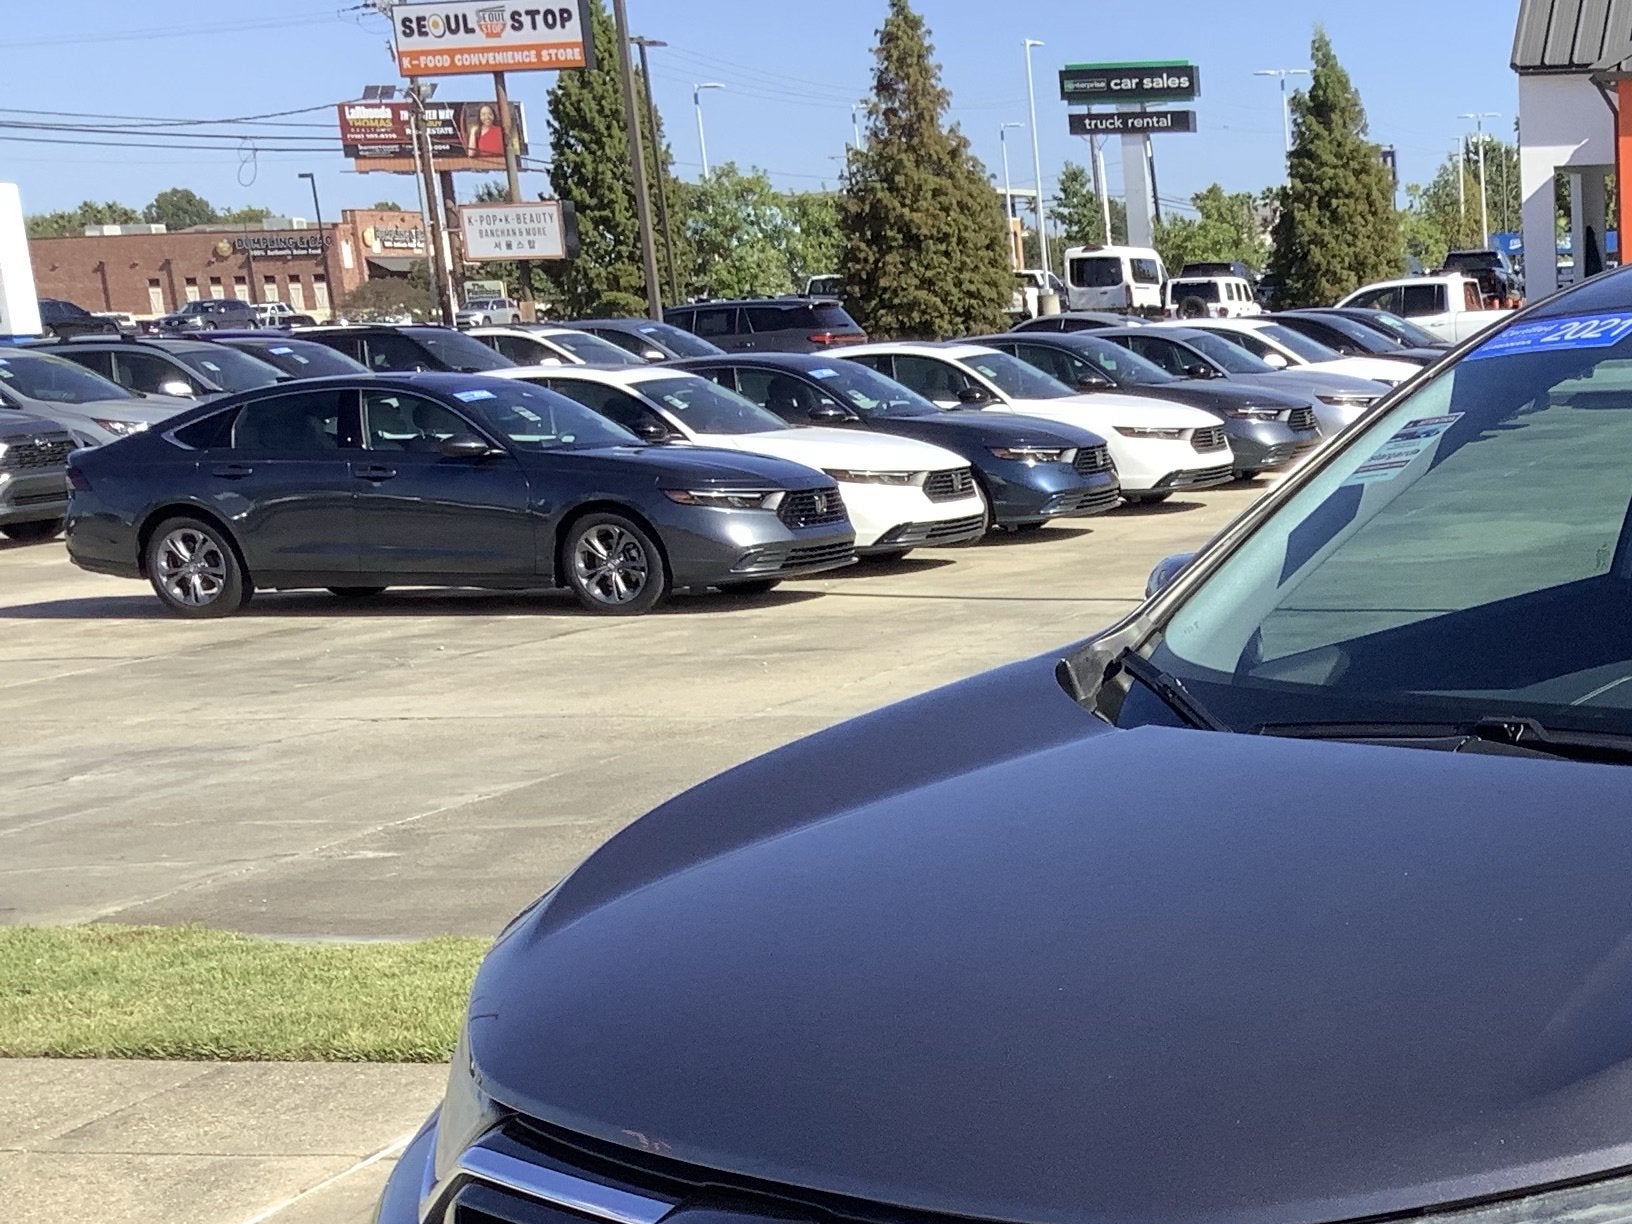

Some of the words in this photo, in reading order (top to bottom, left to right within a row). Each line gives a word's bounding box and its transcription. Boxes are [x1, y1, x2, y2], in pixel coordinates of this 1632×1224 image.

[401, 13, 476, 38] SEOUL
[510, 8, 573, 31] STOP
[402, 55, 451, 69] K-FOOD
[455, 50, 538, 67] CONVENIENCE
[541, 48, 582, 61] STORE
[1110, 79, 1139, 90] car
[1143, 73, 1190, 89] sales
[349, 118, 393, 127] THOMAS
[1084, 115, 1123, 129] truck
[1128, 114, 1172, 128] rental
[478, 229, 517, 238] BANCHAN
[525, 227, 547, 236] MORE
[236, 237, 295, 249] DUMPLING
